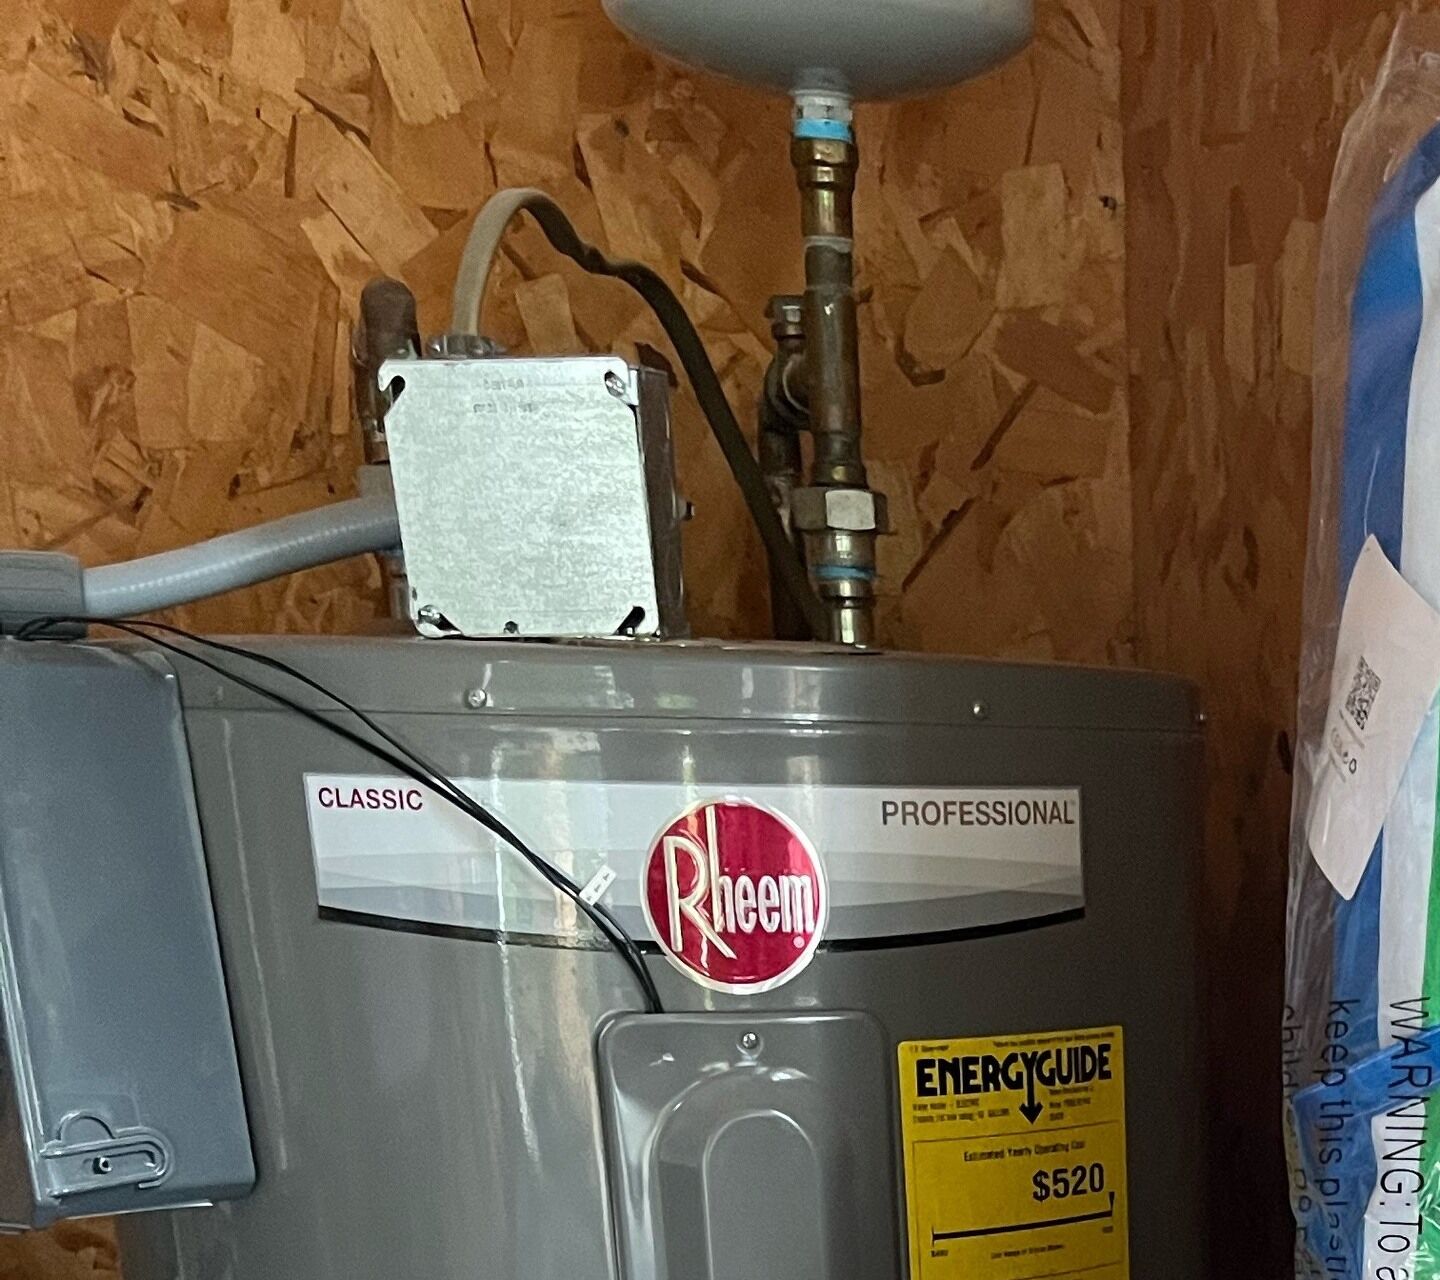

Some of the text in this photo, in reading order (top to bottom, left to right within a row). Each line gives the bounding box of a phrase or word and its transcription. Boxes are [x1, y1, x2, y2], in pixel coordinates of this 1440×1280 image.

[318, 787, 423, 811] CLASSIC
[881, 800, 1075, 826] PROFESSIONAL
[663, 804, 815, 960] Rheem
[916, 1043, 1113, 1098] ENERGYGUIDE
[1313, 1000, 1360, 1087] keep
[1317, 1099, 1355, 1164] this
[1032, 1163, 1105, 1202] $520
